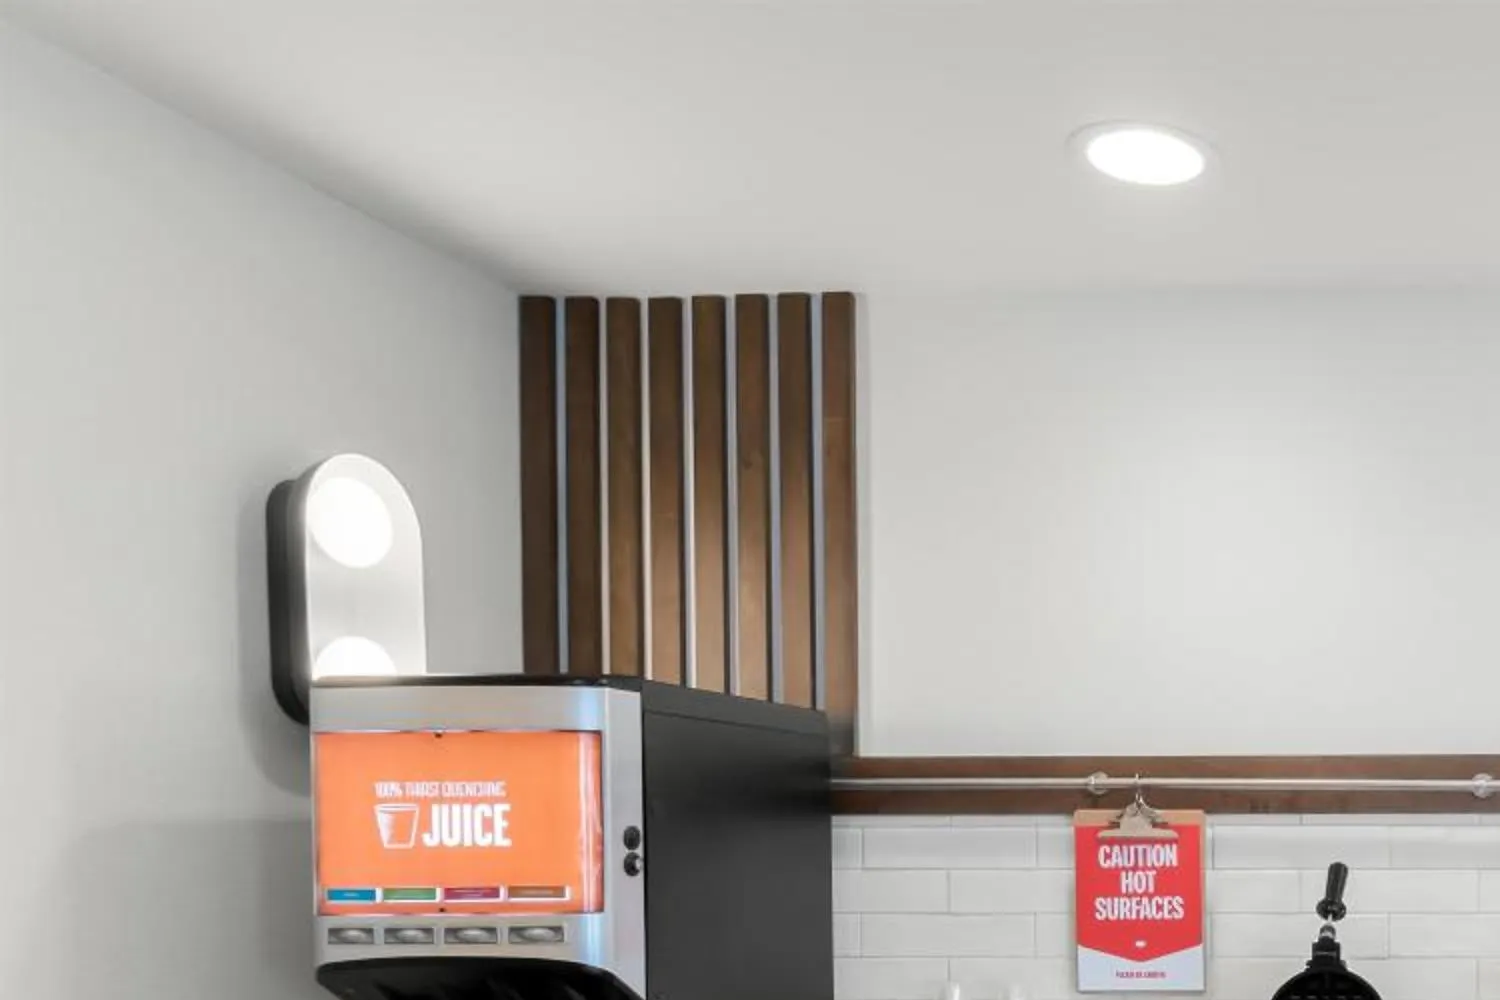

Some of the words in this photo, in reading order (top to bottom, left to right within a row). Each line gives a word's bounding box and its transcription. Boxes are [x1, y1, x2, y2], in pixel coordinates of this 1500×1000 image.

[421, 803, 513, 847] JUICE
[1098, 844, 1178, 868] CAUTION
[1120, 870, 1156, 894] HOT
[1094, 895, 1184, 920] SURFACES
